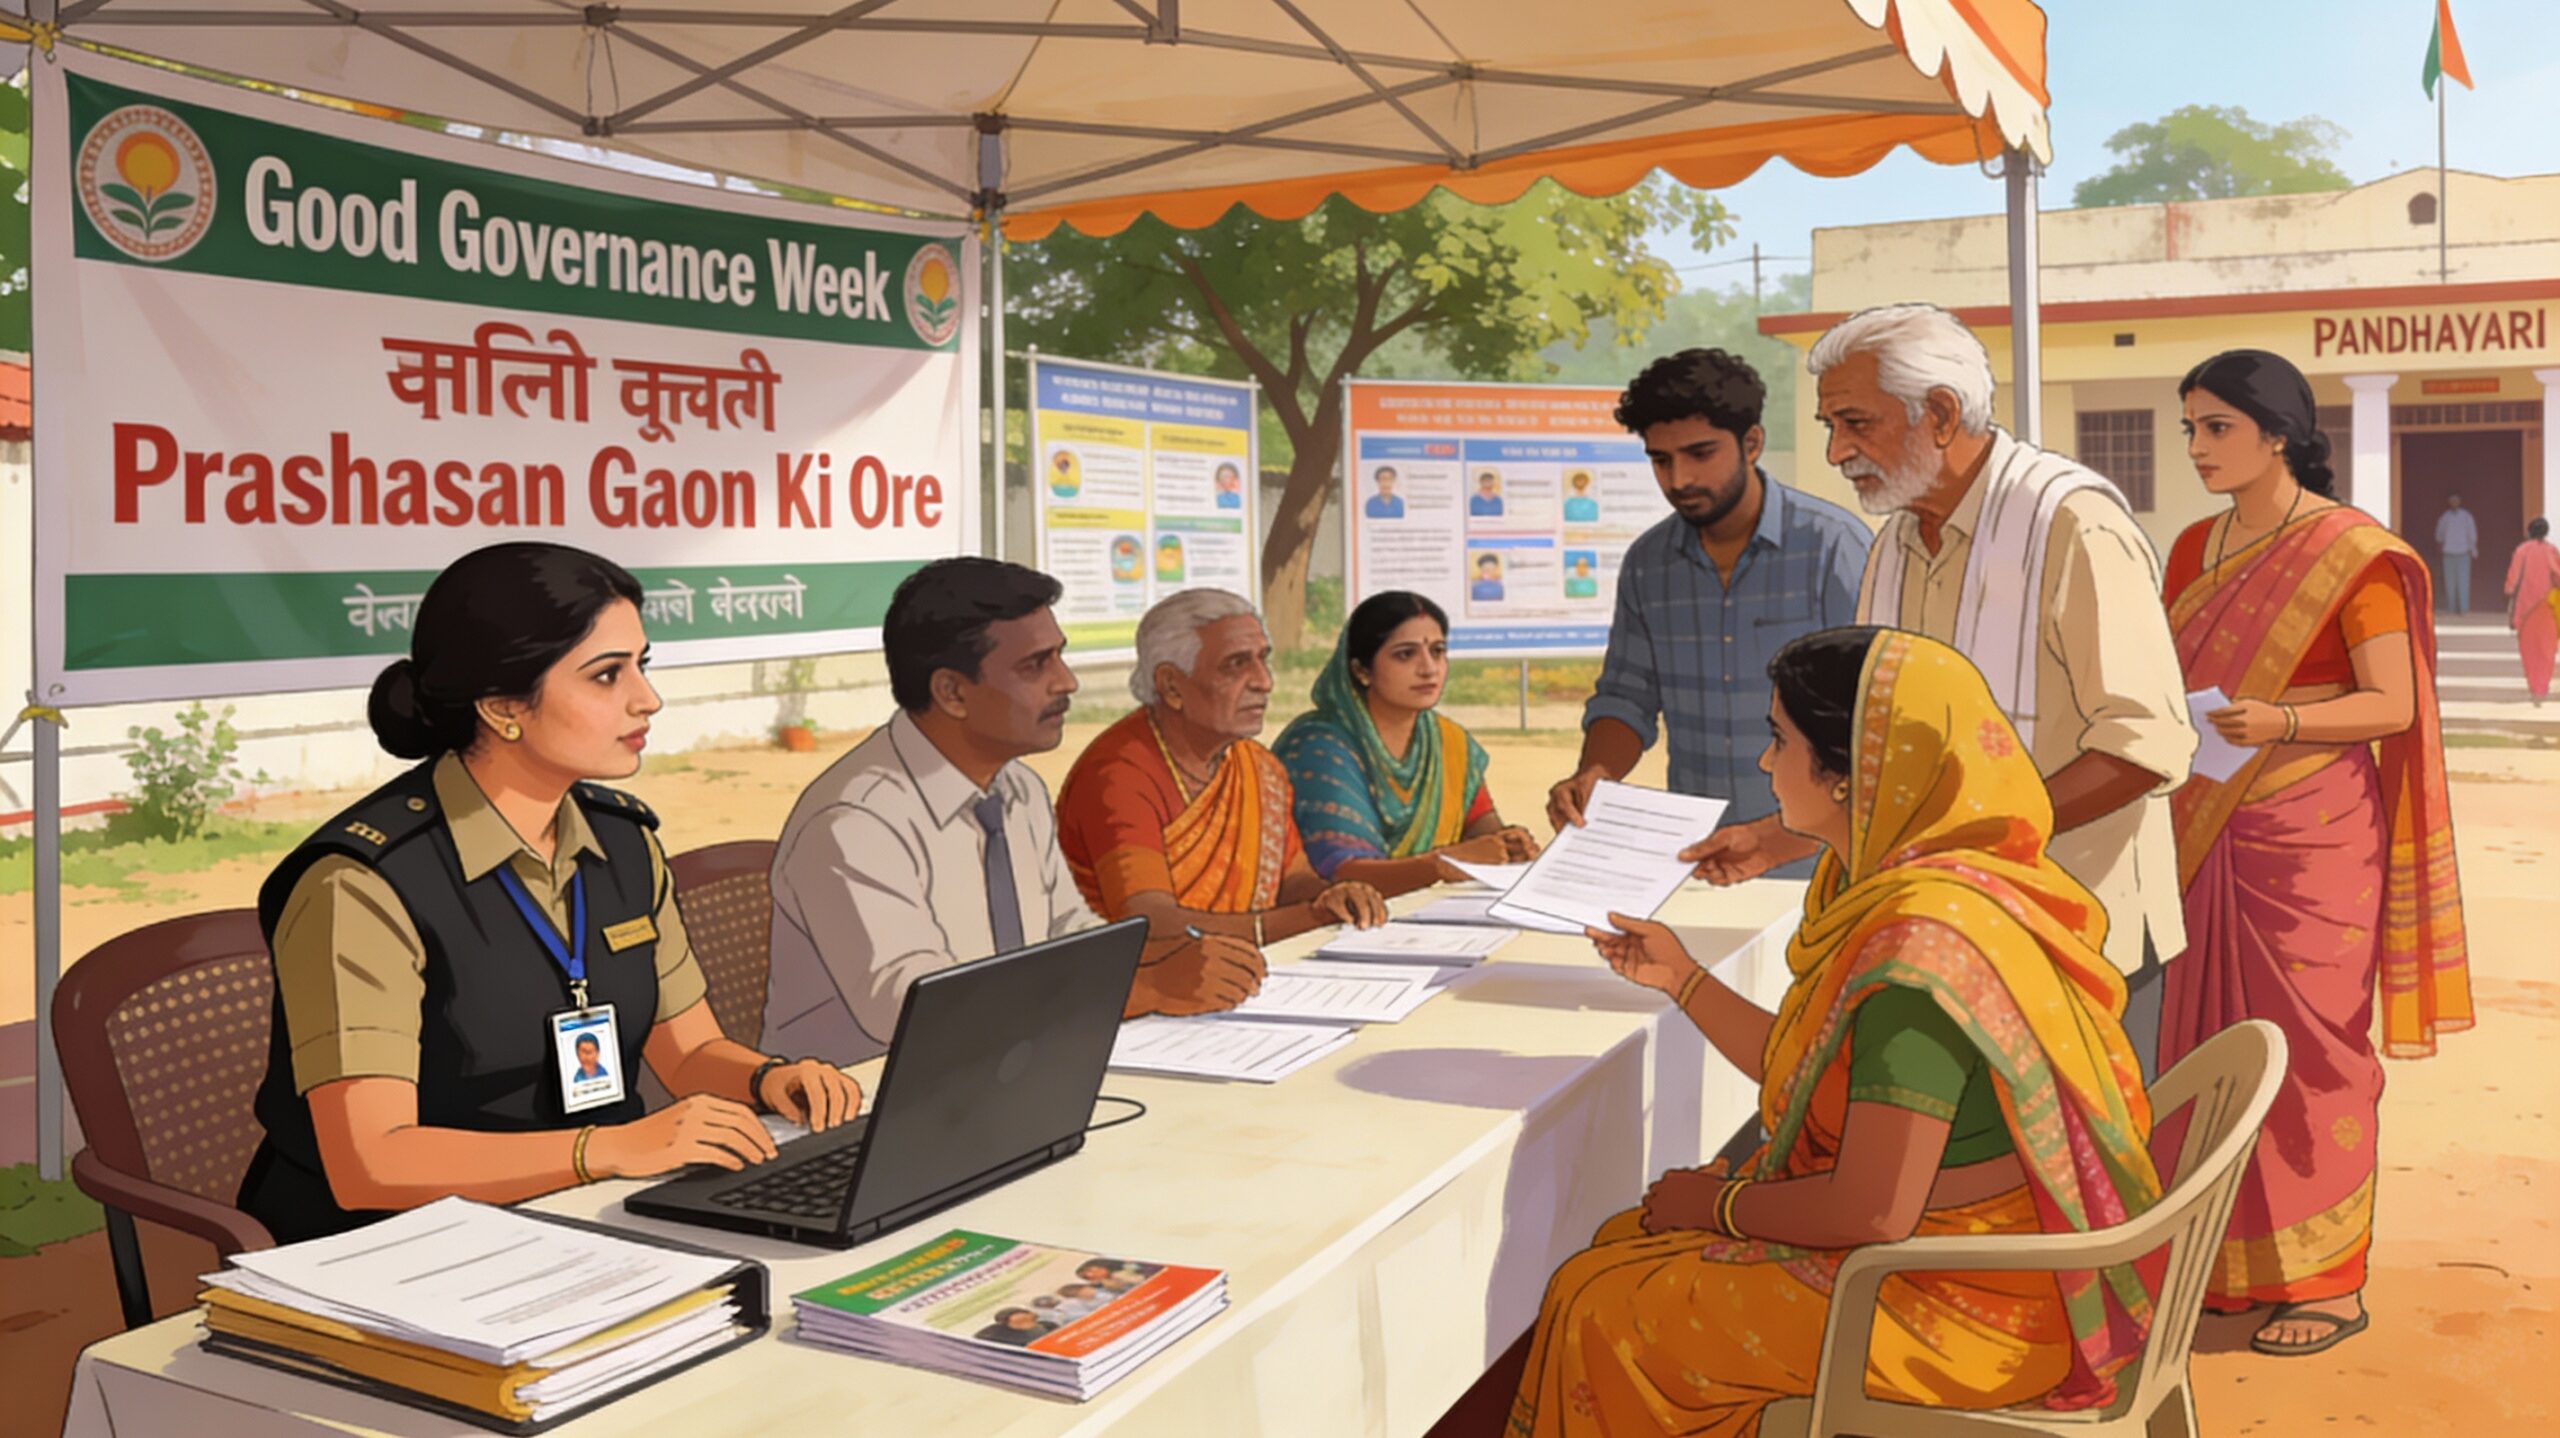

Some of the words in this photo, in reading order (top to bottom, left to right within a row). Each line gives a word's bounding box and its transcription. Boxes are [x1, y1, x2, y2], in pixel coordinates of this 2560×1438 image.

[245, 156, 418, 264] Good
[439, 189, 756, 307] Governance
[766, 238, 892, 323] Week
[2313, 308, 2545, 358] PANDHAYARI
[112, 421, 566, 527] Prashasan
[588, 446, 756, 529] Gaon
[776, 452, 832, 529] Ki
[849, 455, 942, 529] Ore
